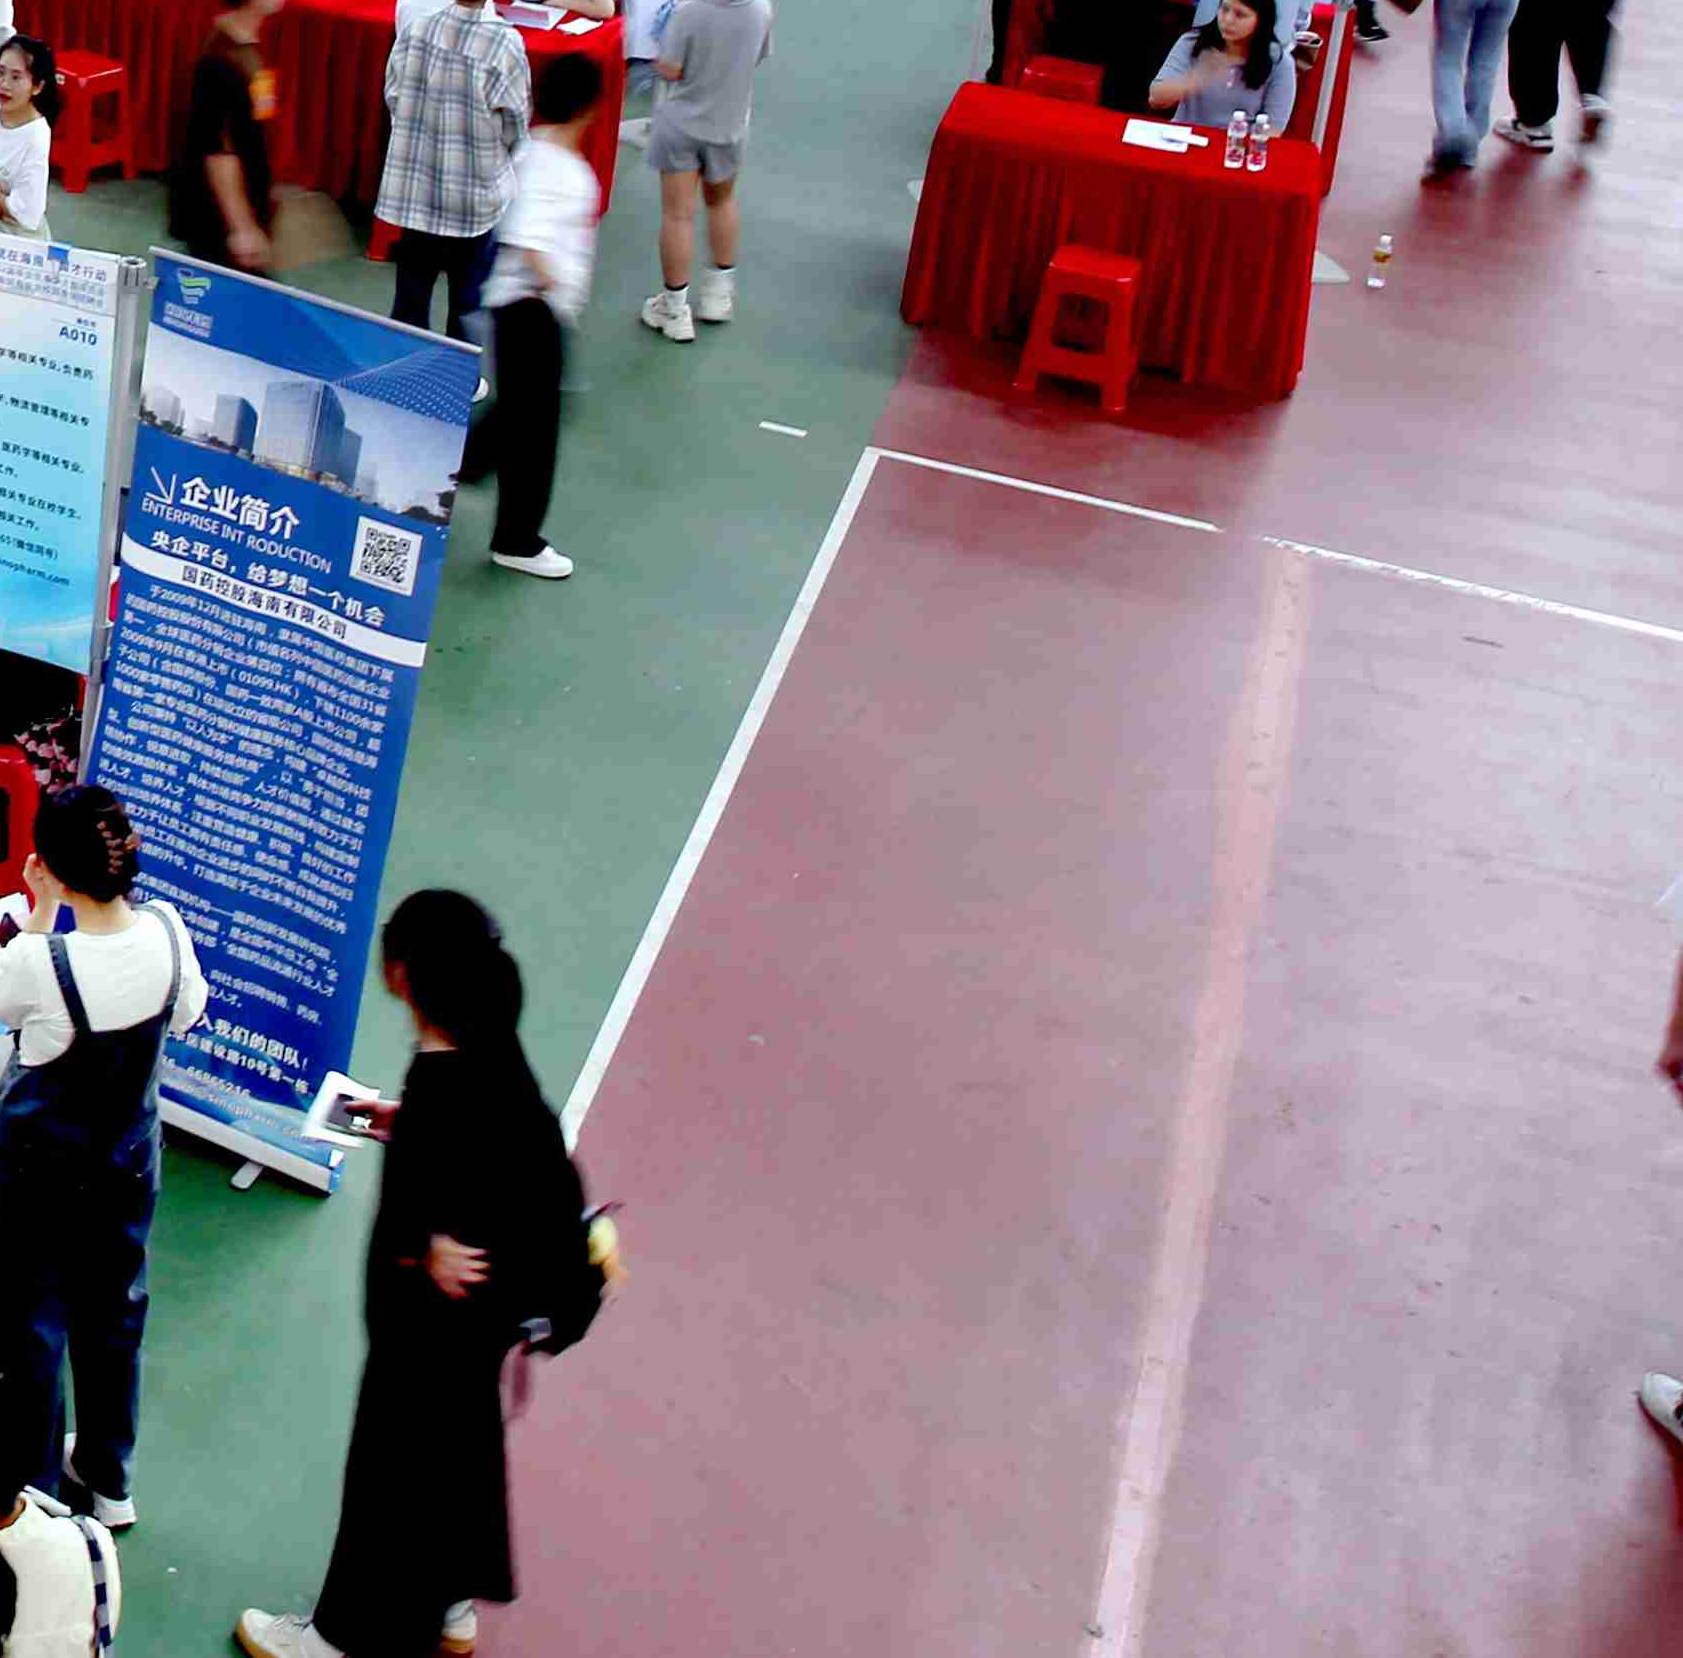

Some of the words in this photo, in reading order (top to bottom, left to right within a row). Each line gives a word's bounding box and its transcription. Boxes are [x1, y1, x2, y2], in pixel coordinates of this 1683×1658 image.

[58, 323, 99, 347] A010
[141, 496, 219, 538] ENTERPRISE
[220, 520, 244, 544] INT
[245, 529, 333, 575] RODUCTION
[180, 475, 301, 540] 企业简介
[150, 528, 386, 628] 央企平台，给梦想一个机会
[181, 564, 349, 641] 国药控股海南有限公司
